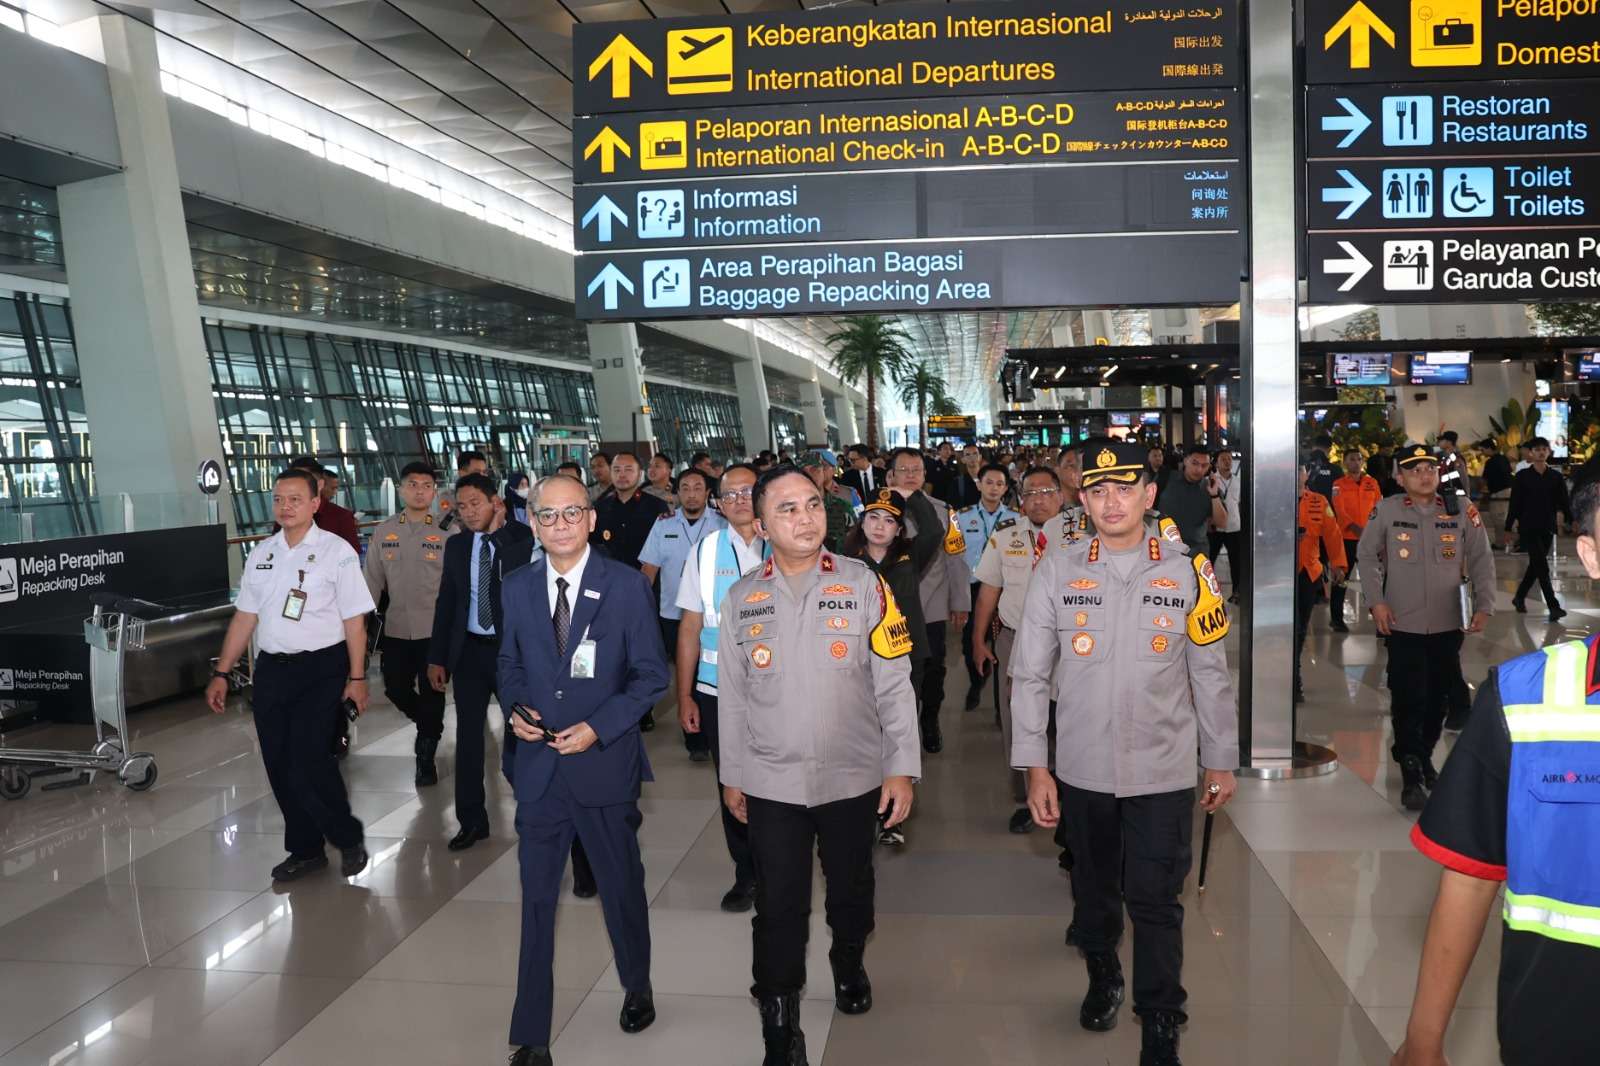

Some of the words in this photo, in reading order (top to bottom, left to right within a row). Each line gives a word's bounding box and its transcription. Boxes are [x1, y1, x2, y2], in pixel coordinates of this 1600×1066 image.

[747, 19, 937, 49] Keberangkatan
[947, 10, 1112, 38] Internasional
[1173, 35, 1224, 48] 国际出发
[1497, 41, 1600, 66] Domest
[747, 62, 904, 92] International
[912, 60, 1056, 88] Departures
[1162, 63, 1224, 77] 国際線出発
[1442, 95, 1550, 117] Restoran
[695, 117, 812, 143] Pelaporan
[819, 106, 969, 134] Internasional
[974, 103, 1074, 127] A-B-C-D
[1442, 119, 1588, 143] Restaurants
[696, 145, 835, 168] International
[843, 138, 945, 162] Check-in
[961, 132, 1061, 157] A-B-C-D
[1503, 165, 1572, 188] Toilet
[693, 184, 798, 210] Informasi
[1191, 187, 1228, 200] 问询处
[1503, 194, 1585, 217] Toilets
[1191, 206, 1229, 219] 案内所
[694, 213, 822, 239] Information
[1443, 238, 1570, 266] Pelayanan
[699, 257, 754, 279] Area
[760, 252, 877, 281] Perapihan
[883, 249, 964, 278] Bagasi
[1443, 267, 1534, 290] Garuda
[1540, 265, 1600, 289] Cust
[699, 286, 801, 313] Baggage
[808, 280, 930, 309] Repacking
[936, 278, 992, 300] Area
[20, 554, 57, 577] Meja
[59, 548, 125, 571] Perapihan
[21, 574, 78, 597] Repacking
[79, 570, 106, 588] Desk
[817, 600, 858, 611] POLRI
[1062, 595, 1103, 606] WISNU
[1142, 595, 1185, 609] POLRI
[14, 669, 37, 681] Meja
[38, 669, 83, 683] Perapihan
